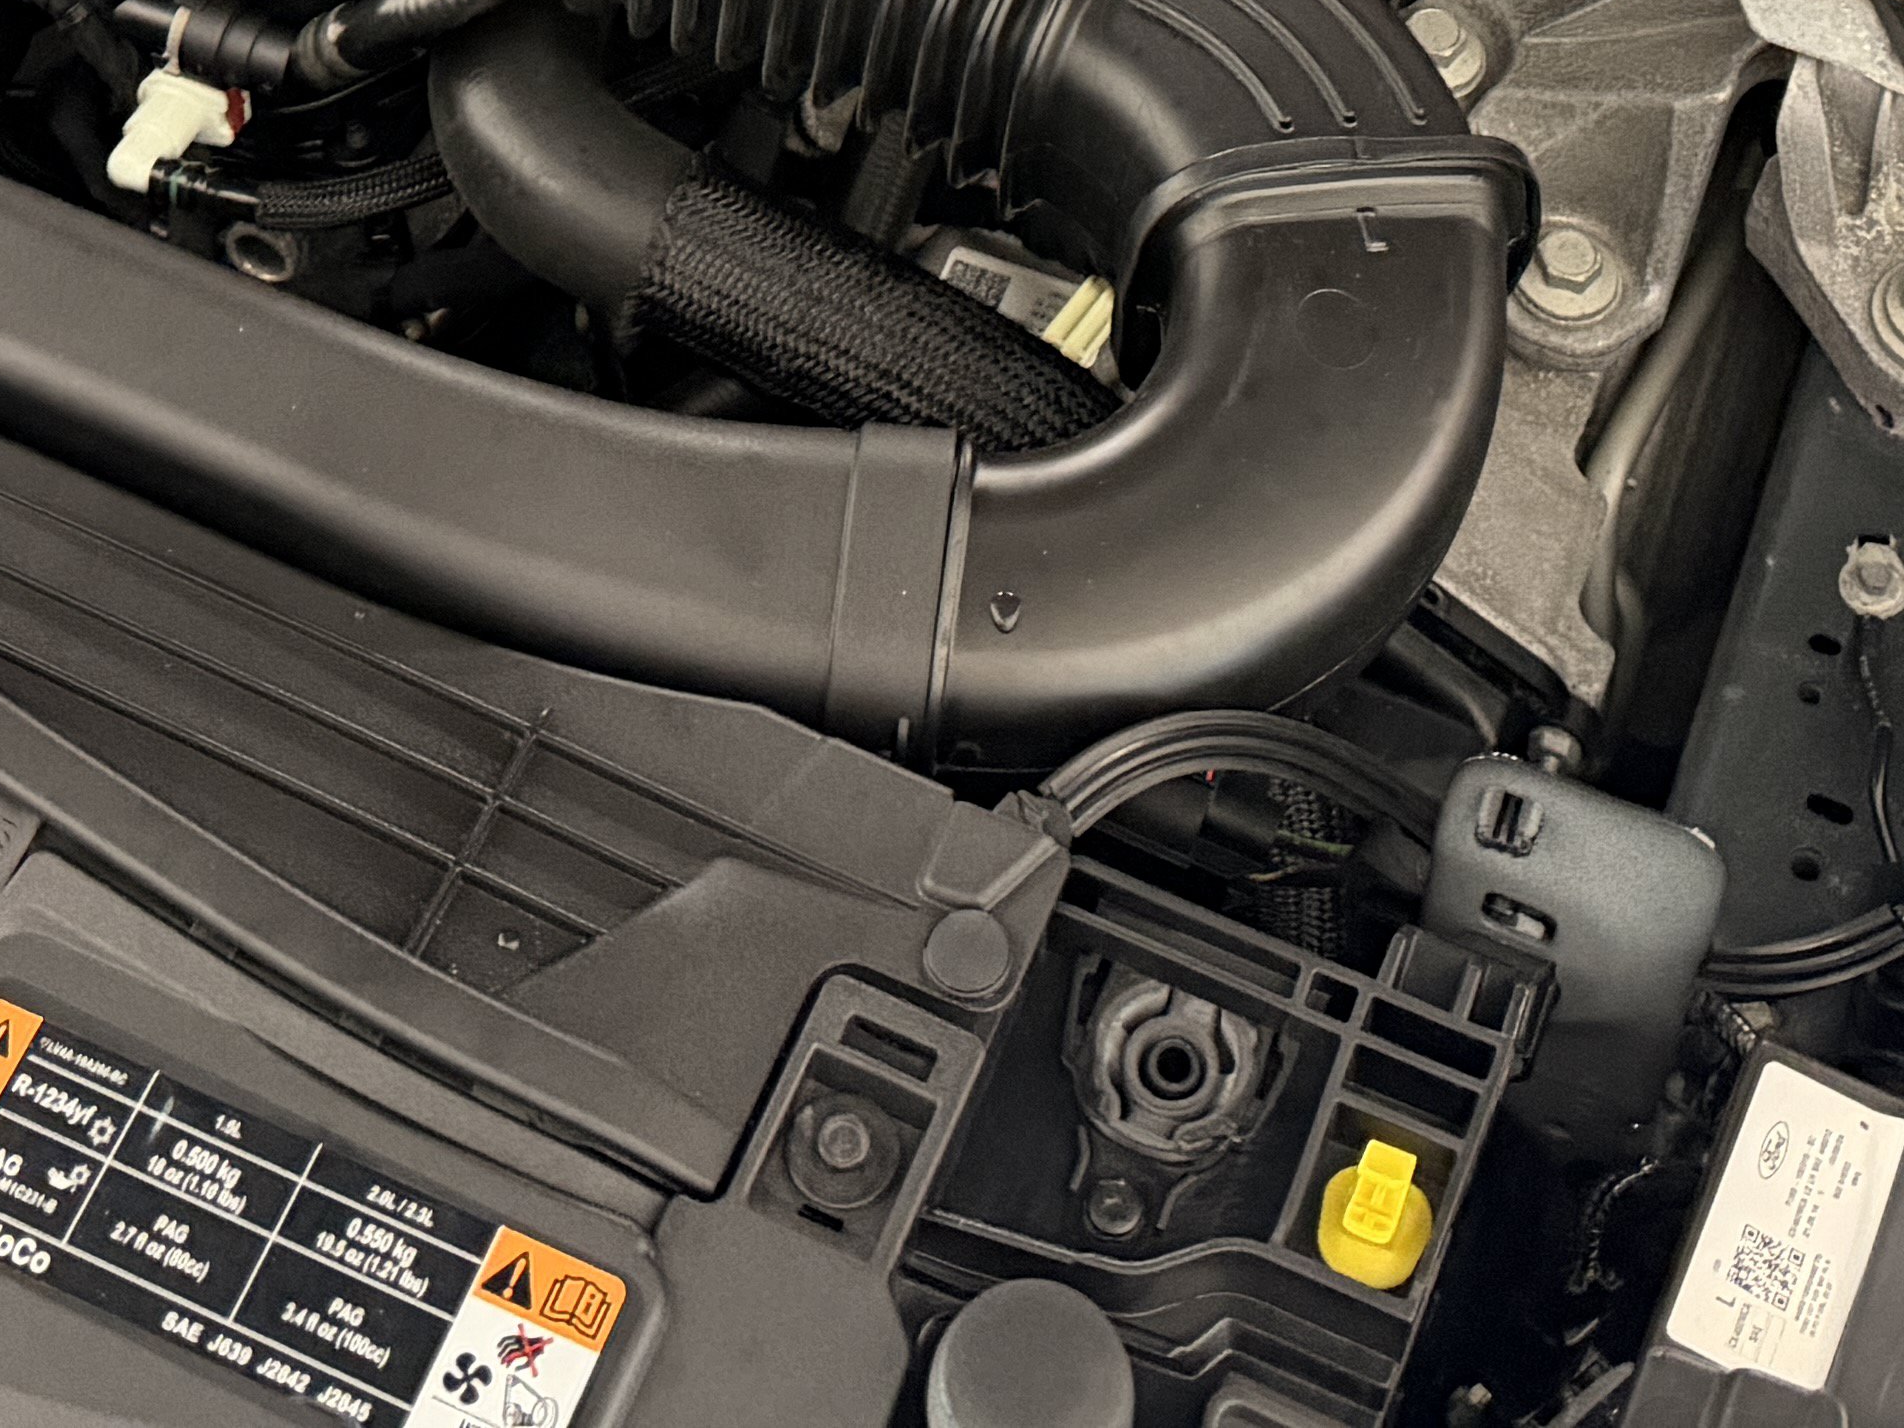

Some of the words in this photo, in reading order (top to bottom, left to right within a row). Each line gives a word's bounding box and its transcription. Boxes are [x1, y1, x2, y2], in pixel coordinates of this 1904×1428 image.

[12, 1073, 98, 1125] R-1234yf
[147, 1155, 167, 1176] 18
[164, 1167, 185, 1186] oz
[171, 1139, 220, 1175] 0.500
[216, 1159, 242, 1189] kg
[110, 1221, 138, 1245] 2.7
[133, 1231, 149, 1251] fl
[145, 1241, 166, 1260] oz
[163, 1246, 210, 1283] (80cc)
[153, 1214, 190, 1244] PAG
[346, 1217, 394, 1253] 0.550
[391, 1237, 418, 1269] kg
[315, 1231, 348, 1257] 19.5
[344, 1247, 366, 1266] oz
[362, 1253, 400, 1282] (1.21
[280, 1301, 308, 1327] 3.4
[305, 1312, 321, 1333] fl
[317, 1322, 339, 1342] oz
[335, 1328, 391, 1370] (100cc)
[327, 1297, 366, 1327] PAG
[161, 1310, 206, 1344] SAE
[206, 1333, 254, 1366] J639
